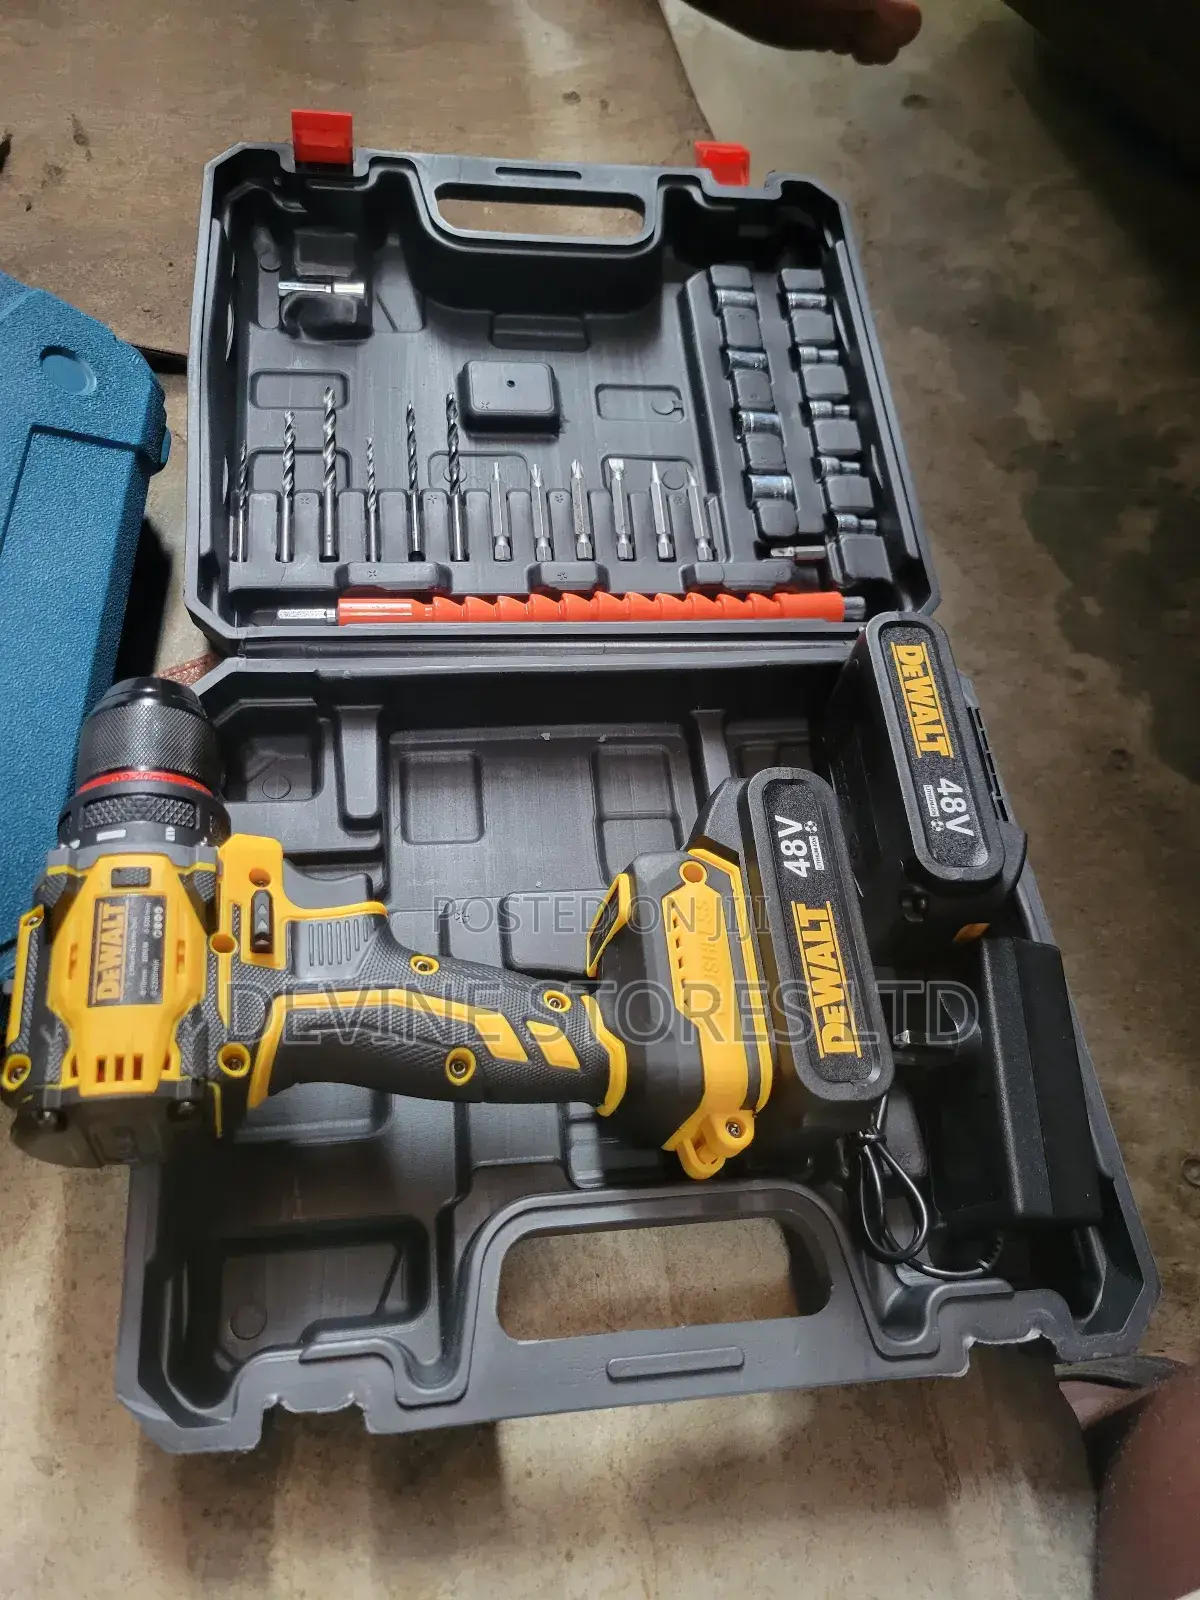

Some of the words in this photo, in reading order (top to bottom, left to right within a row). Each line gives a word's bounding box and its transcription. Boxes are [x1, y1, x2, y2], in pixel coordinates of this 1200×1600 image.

[892, 642, 954, 758] DEWALT
[775, 815, 811, 878] 48V
[937, 778, 975, 836] 48V
[95, 902, 127, 1002] DEWALT
[793, 901, 861, 1057] DEWALT
